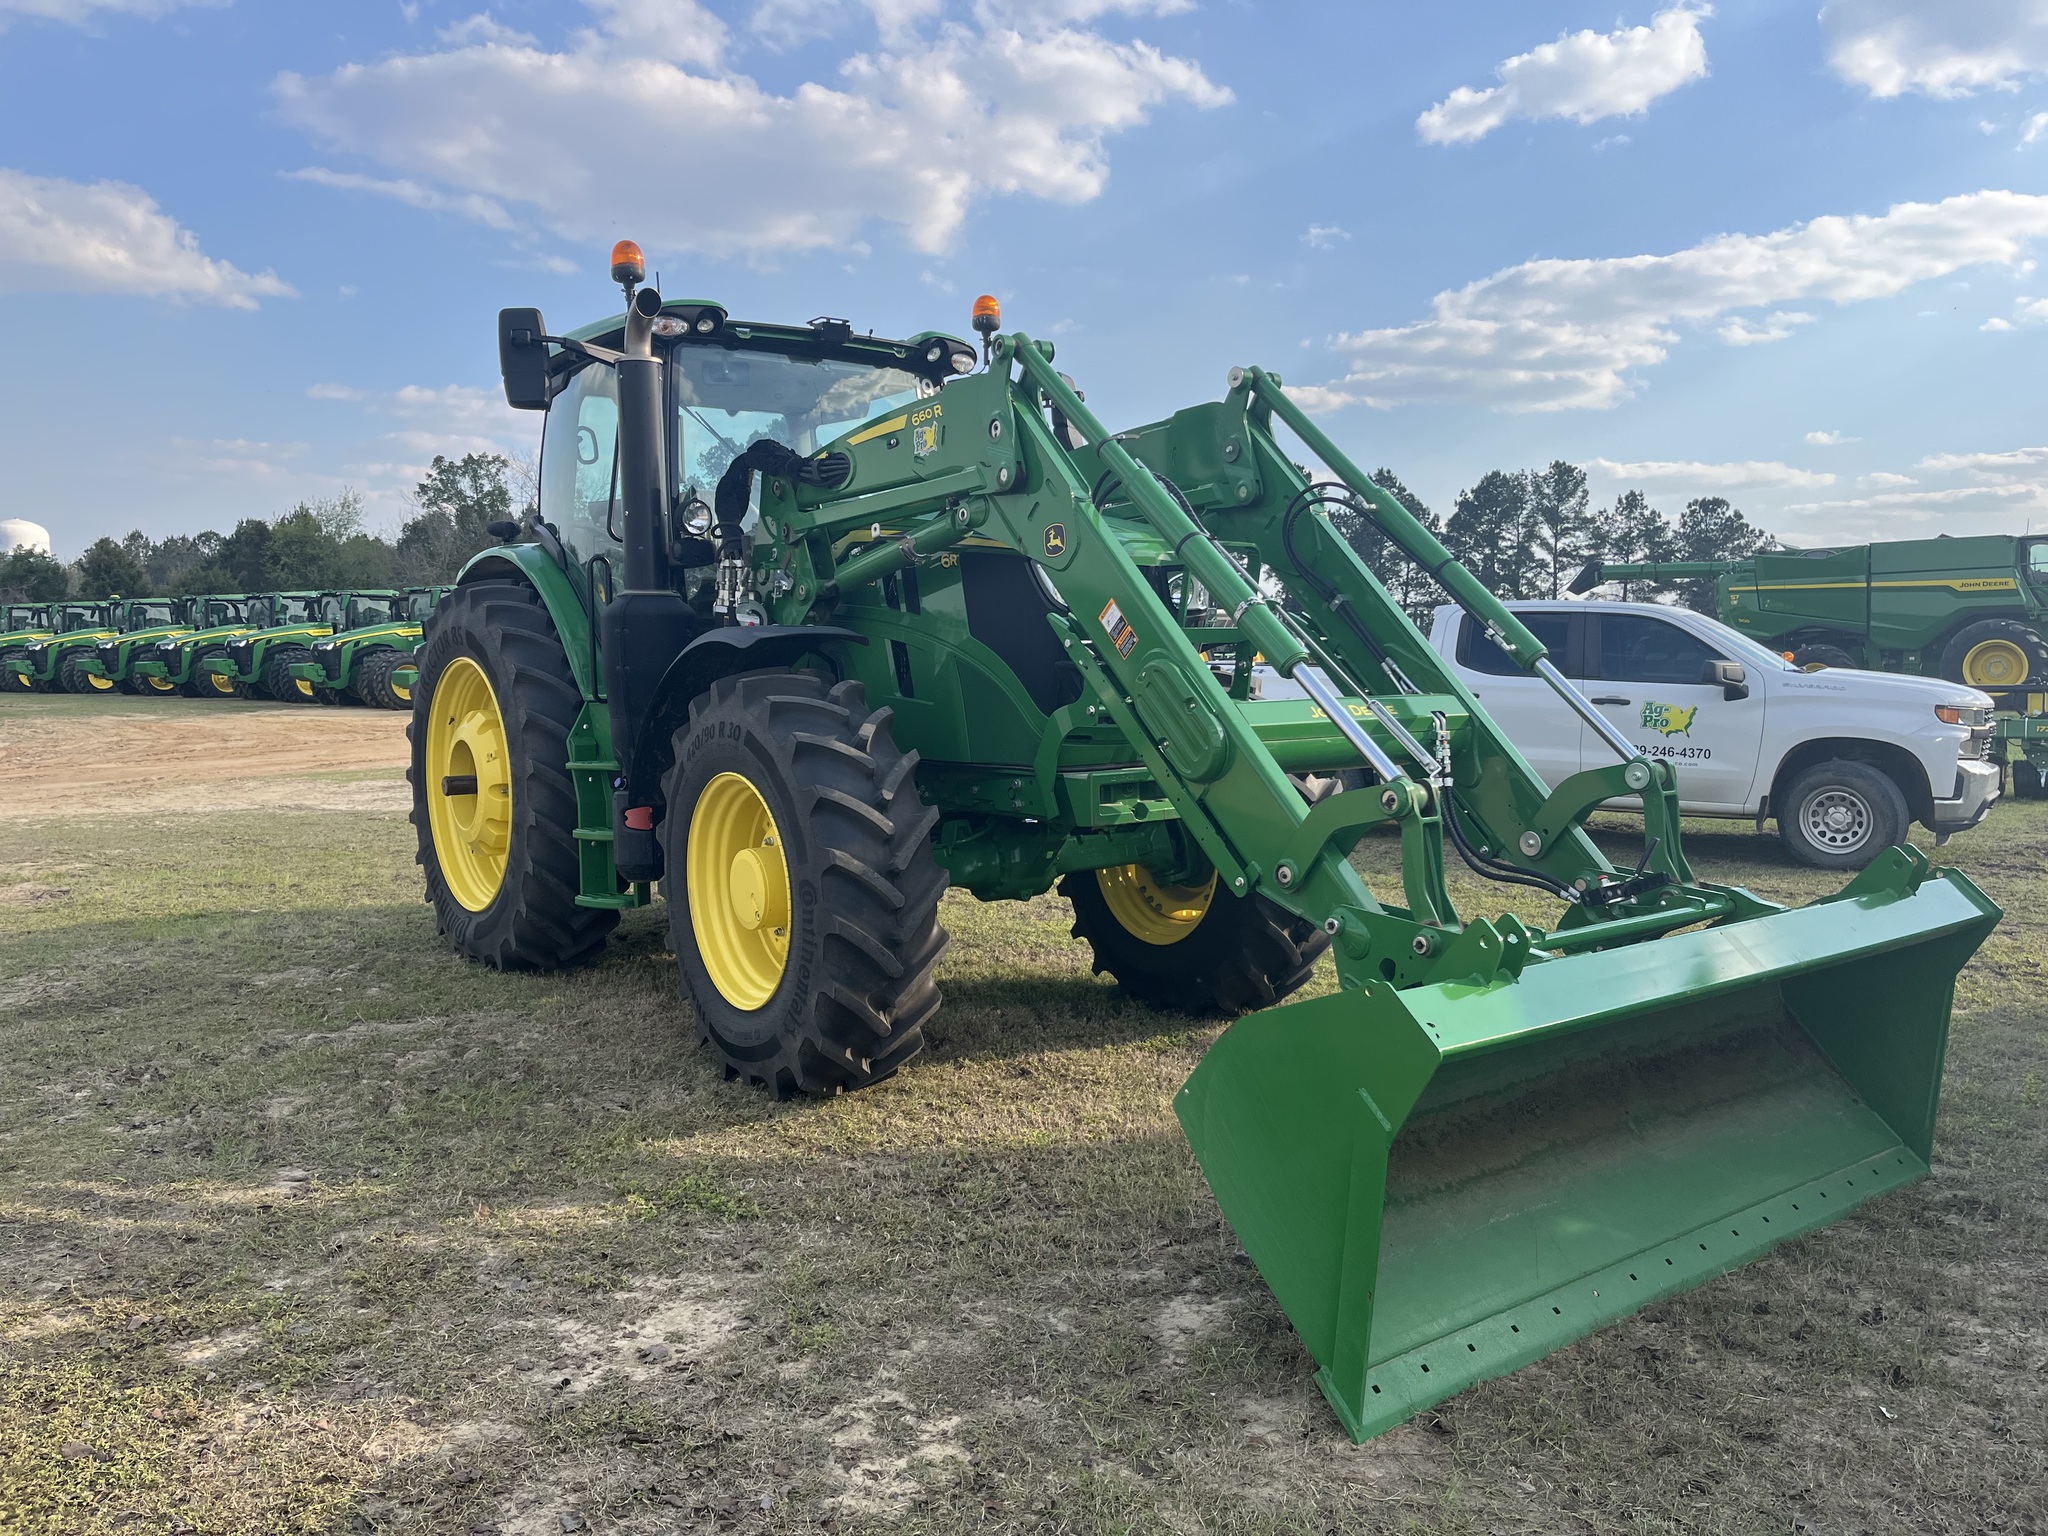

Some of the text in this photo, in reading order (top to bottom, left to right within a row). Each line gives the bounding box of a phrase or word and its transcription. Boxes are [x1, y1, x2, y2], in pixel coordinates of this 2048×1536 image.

[911, 404, 943, 426] 660 R
[940, 553, 957, 568] 6R
[451, 625, 464, 646] 85
[1348, 704, 1399, 717] DEE
[1641, 702, 1671, 717] Ag-
[1641, 714, 1670, 728] Pro
[718, 721, 726, 738] R
[727, 721, 742, 742] 30
